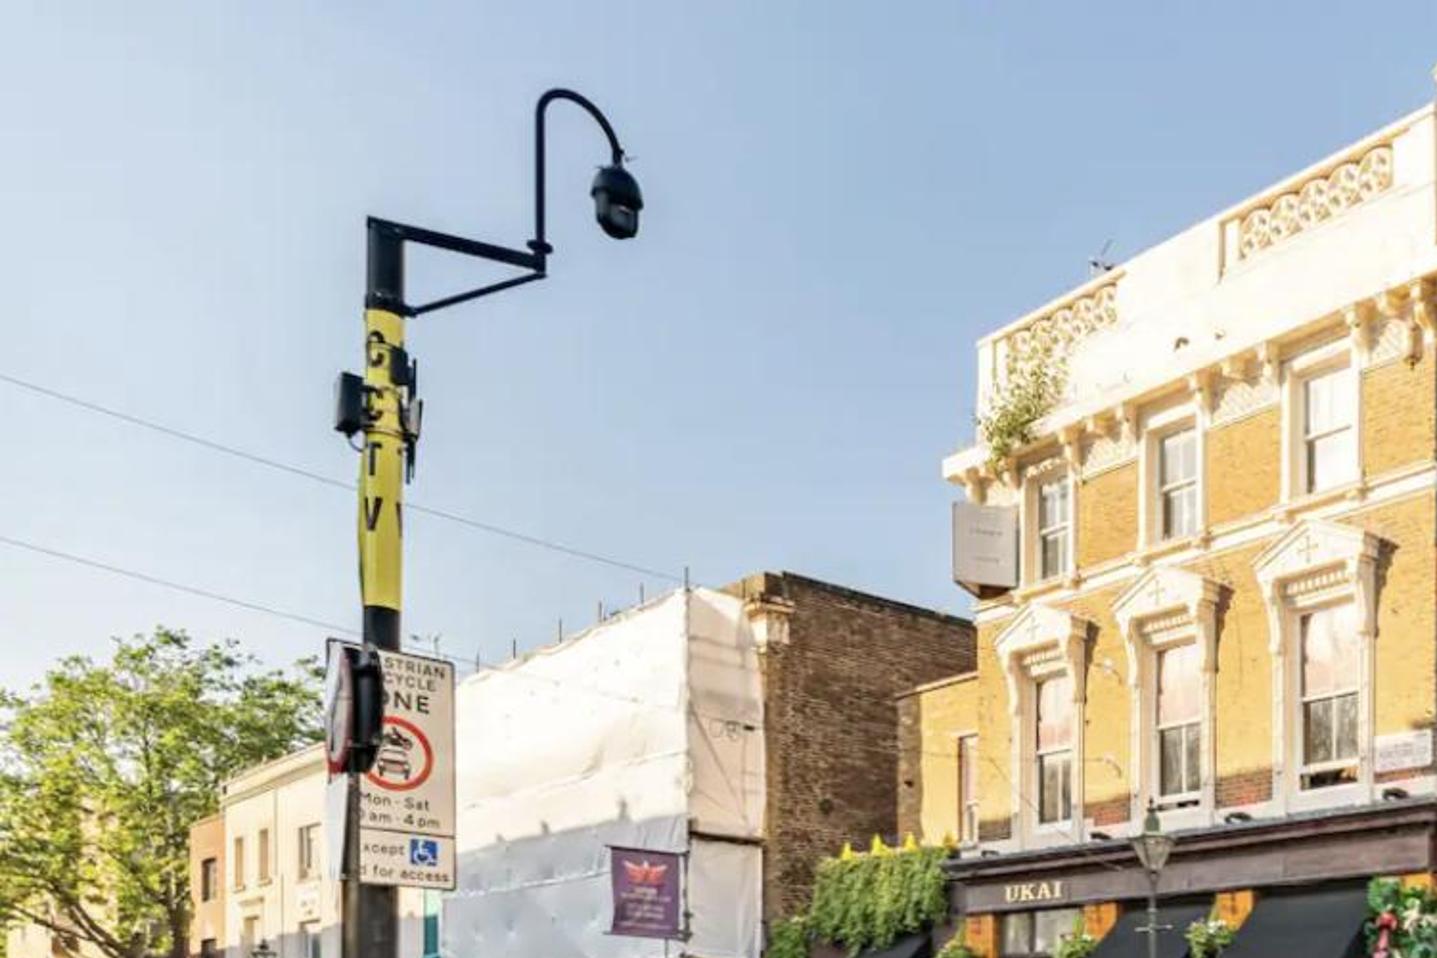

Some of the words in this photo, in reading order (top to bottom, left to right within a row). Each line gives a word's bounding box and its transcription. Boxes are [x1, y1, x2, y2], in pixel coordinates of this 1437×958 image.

[384, 656, 446, 680] STRIAN
[404, 797, 430, 811] Sat
[403, 814, 414, 825] 4
[417, 818, 440, 829] pm
[363, 843, 405, 856] xcept
[373, 865, 394, 878] for
[400, 870, 449, 882] access
[1005, 881, 1063, 902] UKAI
